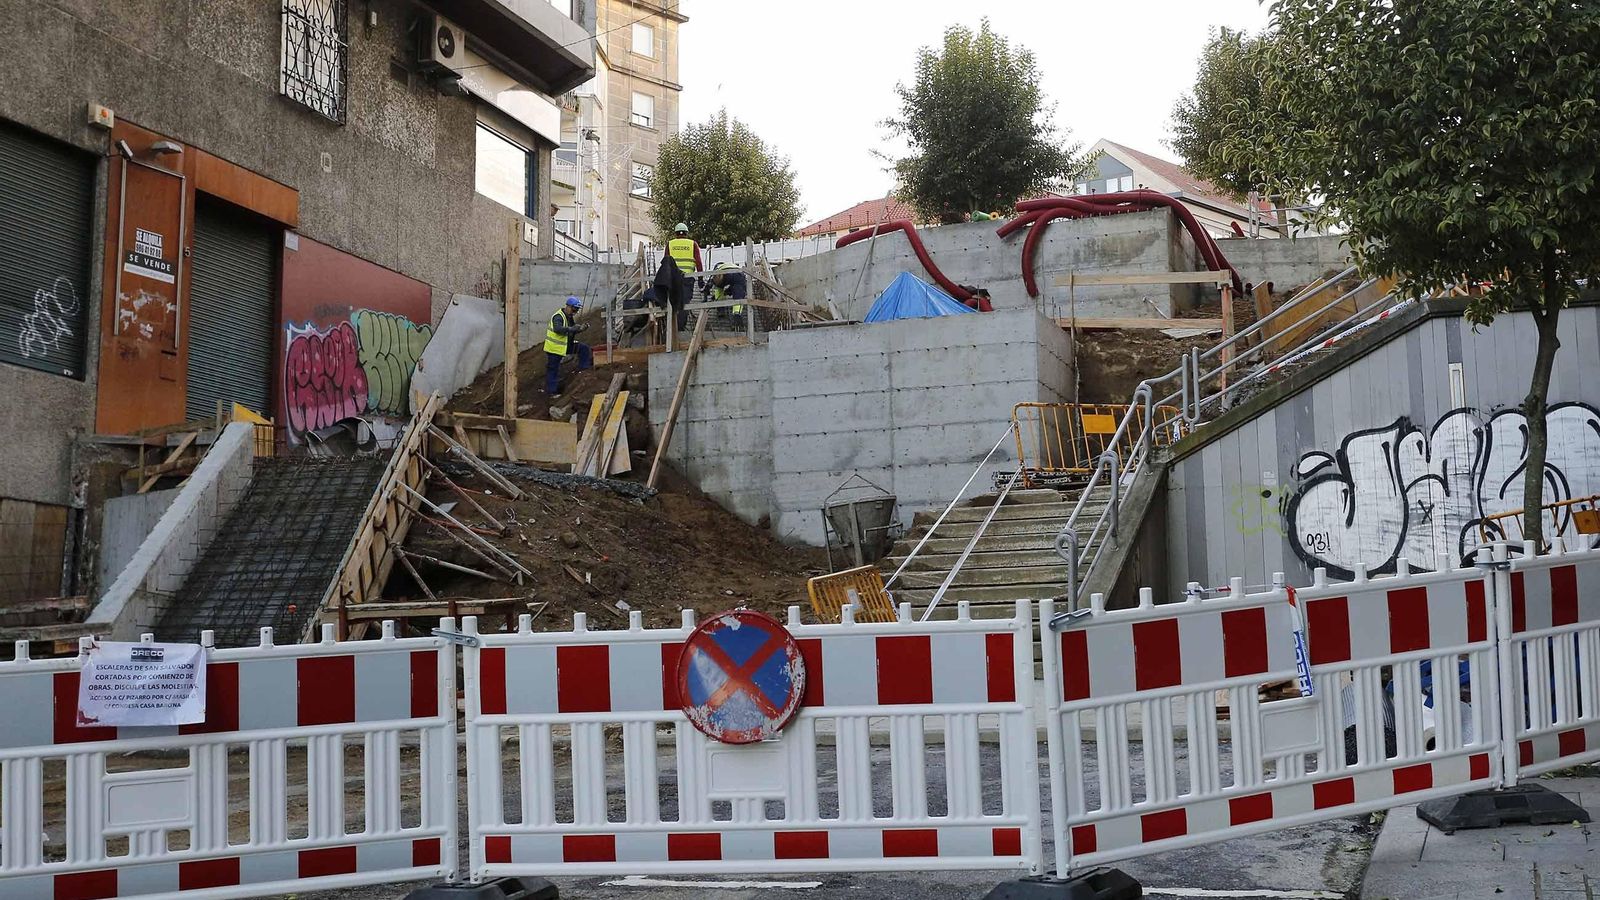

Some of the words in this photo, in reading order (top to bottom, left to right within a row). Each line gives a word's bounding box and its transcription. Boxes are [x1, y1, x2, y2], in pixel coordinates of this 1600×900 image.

[184, 246, 191, 257] 5
[129, 254, 139, 263] SE
[144, 258, 171, 272] VENDE
